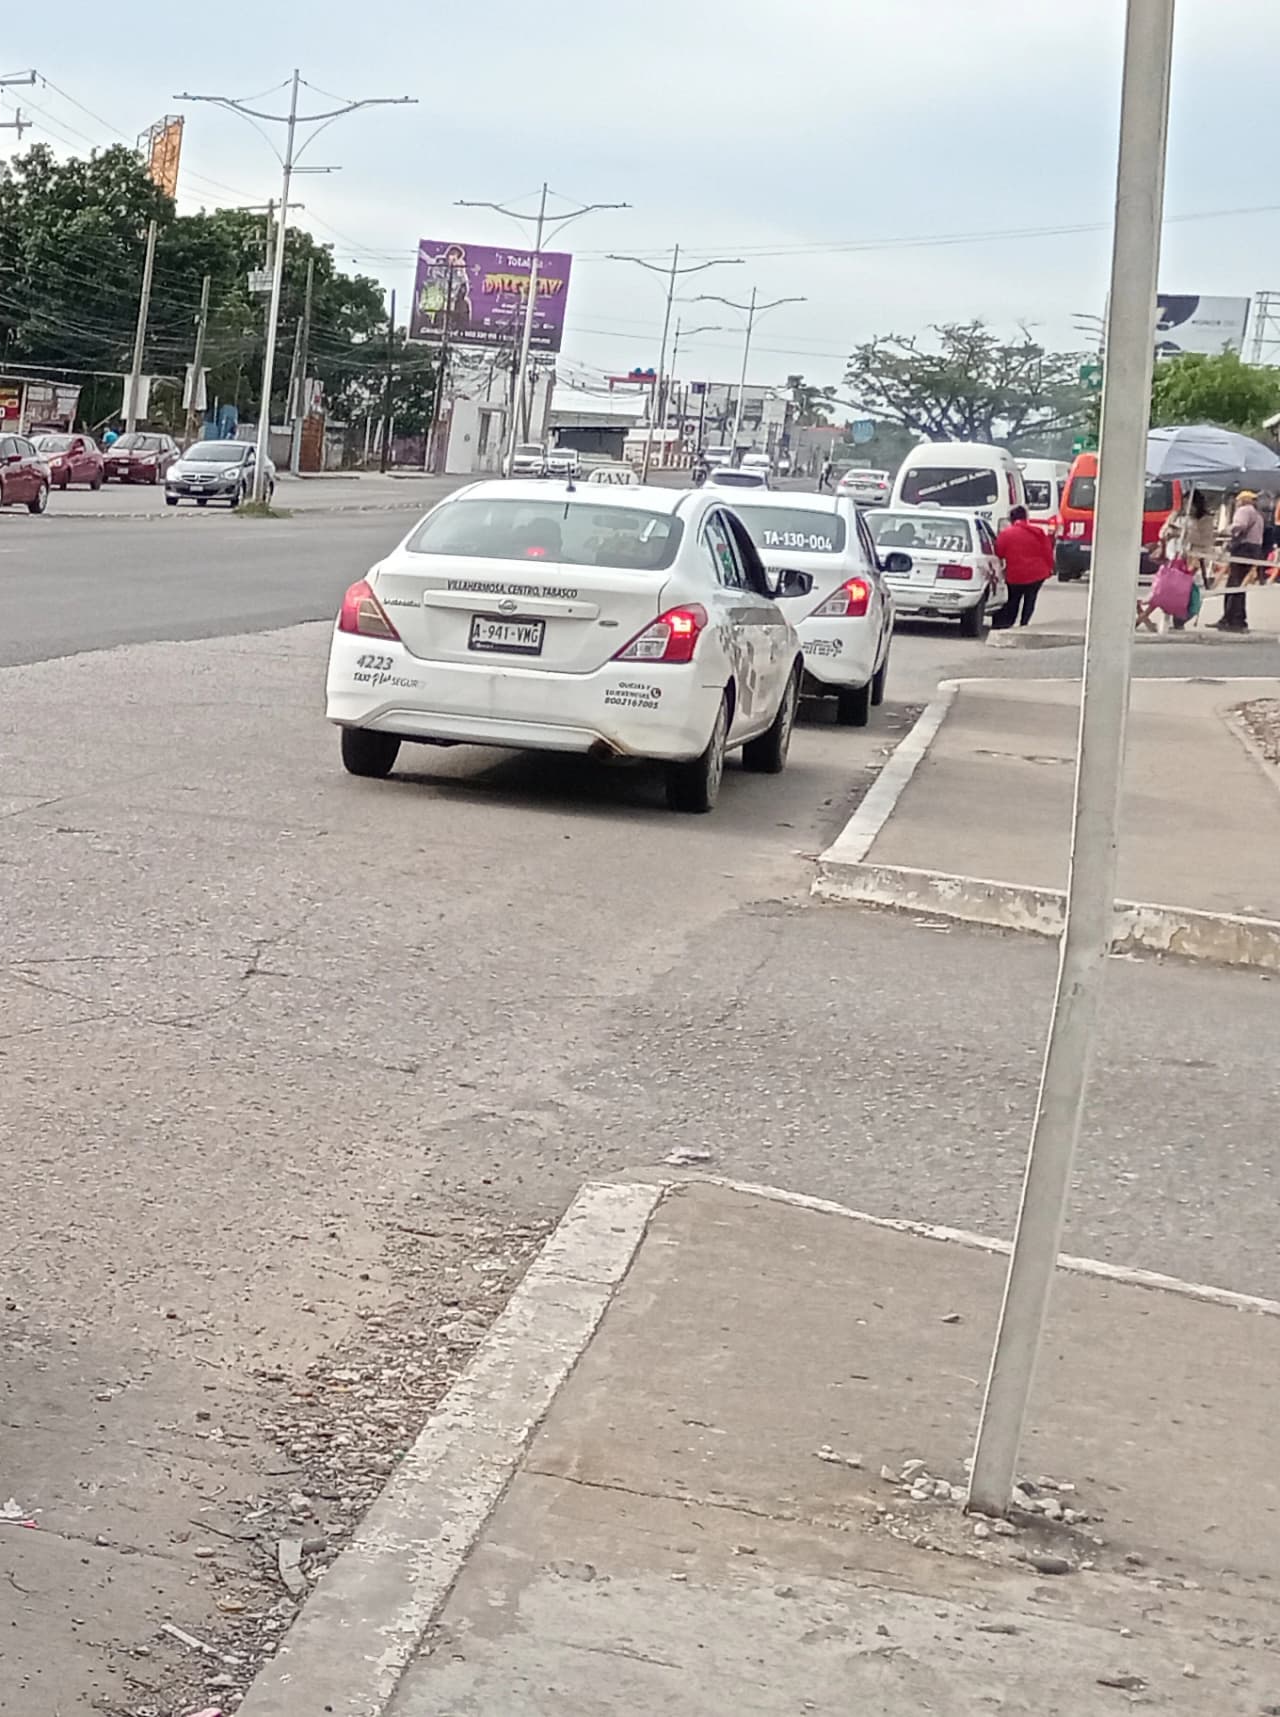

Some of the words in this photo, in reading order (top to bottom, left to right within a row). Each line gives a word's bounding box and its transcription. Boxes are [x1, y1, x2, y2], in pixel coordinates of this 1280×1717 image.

[596, 472, 631, 485] TAXI
[763, 531, 833, 550] TA-130-004
[542, 587, 578, 599] TABASCO
[473, 623, 539, 644] A-941-VMG
[356, 655, 394, 671] 4223
